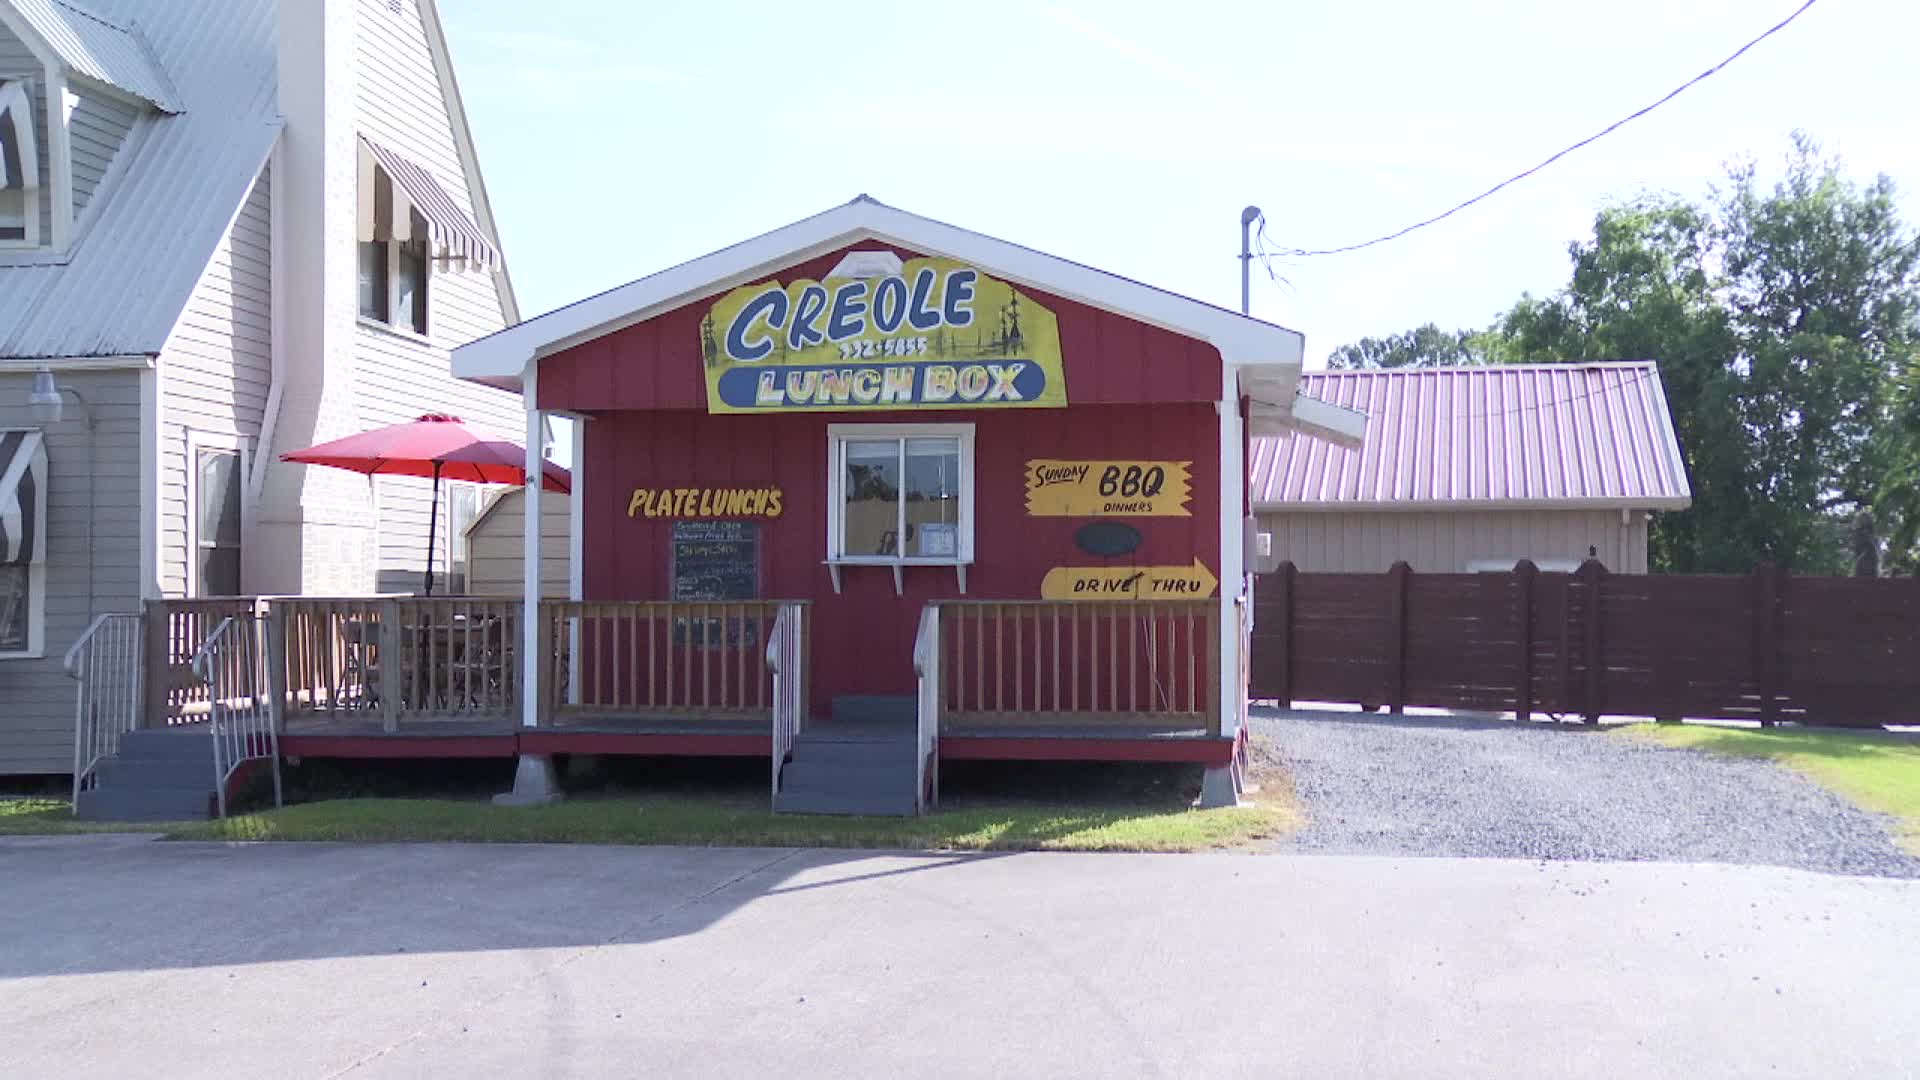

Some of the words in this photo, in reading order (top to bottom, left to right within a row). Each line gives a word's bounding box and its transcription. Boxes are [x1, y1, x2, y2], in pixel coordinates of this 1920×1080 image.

[725, 268, 977, 361] CREOLE
[756, 365, 915, 406] LUNCH
[921, 362, 1025, 401] BOX
[1099, 464, 1165, 498] BBQ
[1103, 501, 1153, 514] DINNERS
[1073, 577, 1134, 594] DRIVE
[1151, 579, 1201, 594] THRU
